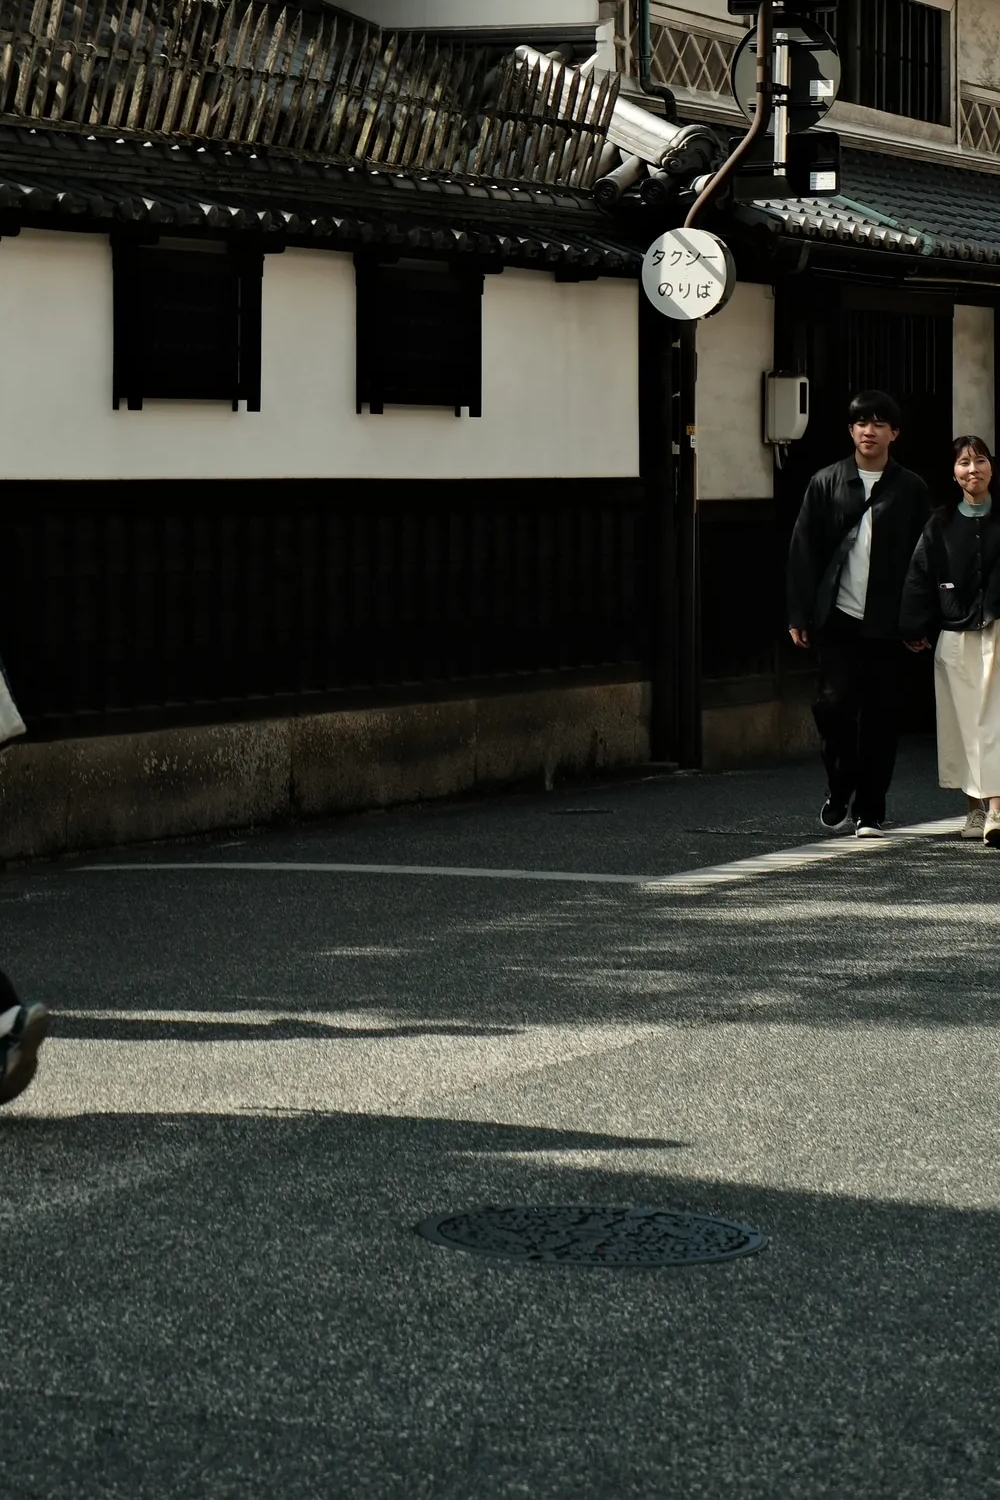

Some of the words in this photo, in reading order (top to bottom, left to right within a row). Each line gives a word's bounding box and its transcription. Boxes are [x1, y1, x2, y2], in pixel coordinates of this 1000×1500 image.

[652, 249, 718, 267] タクシー
[657, 280, 713, 299] のりば
